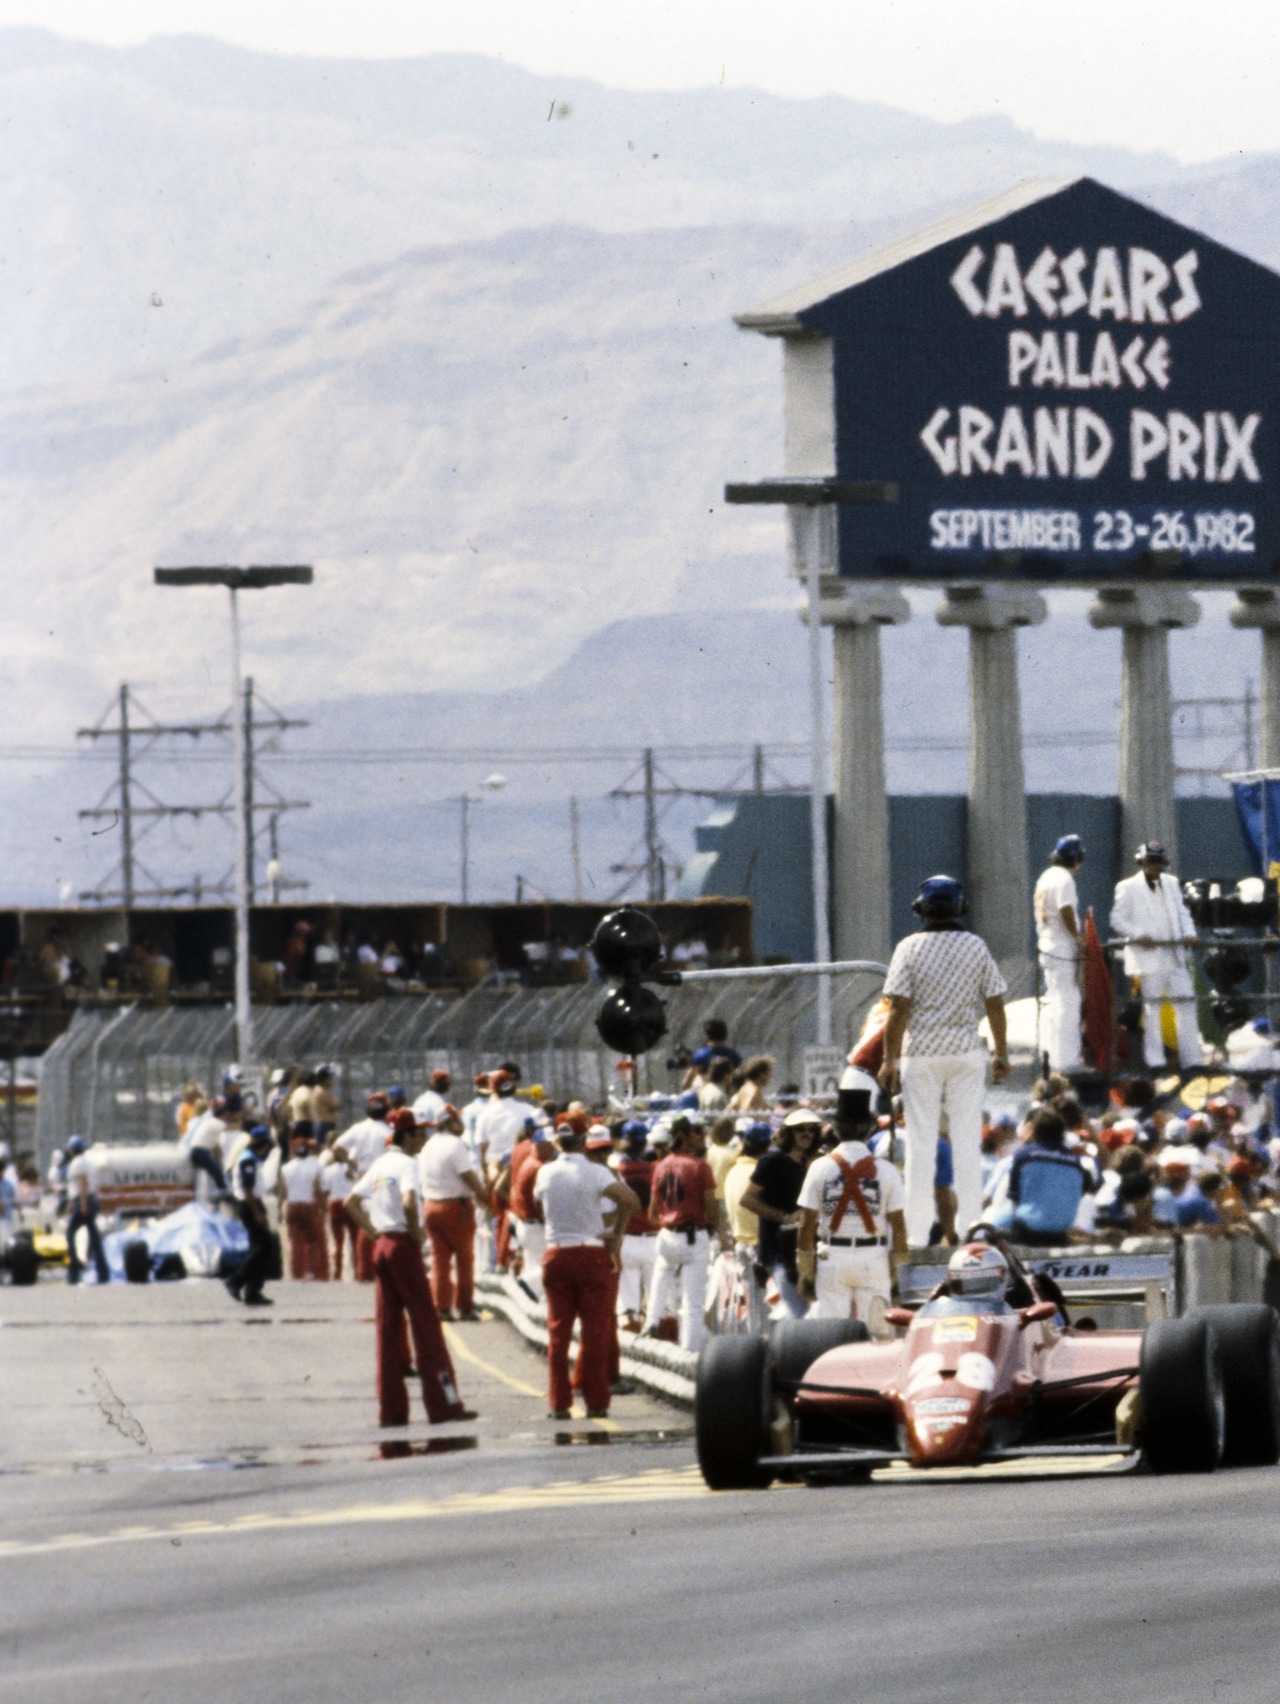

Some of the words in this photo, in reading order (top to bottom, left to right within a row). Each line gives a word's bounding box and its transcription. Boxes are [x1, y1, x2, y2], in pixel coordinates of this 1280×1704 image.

[950, 243, 1201, 324] CAESARS
[1009, 331, 1170, 390] PALACE
[920, 406, 1114, 478] GRAND
[1130, 408, 1262, 482] PRIX
[929, 509, 1081, 550] SEPTEMBER
